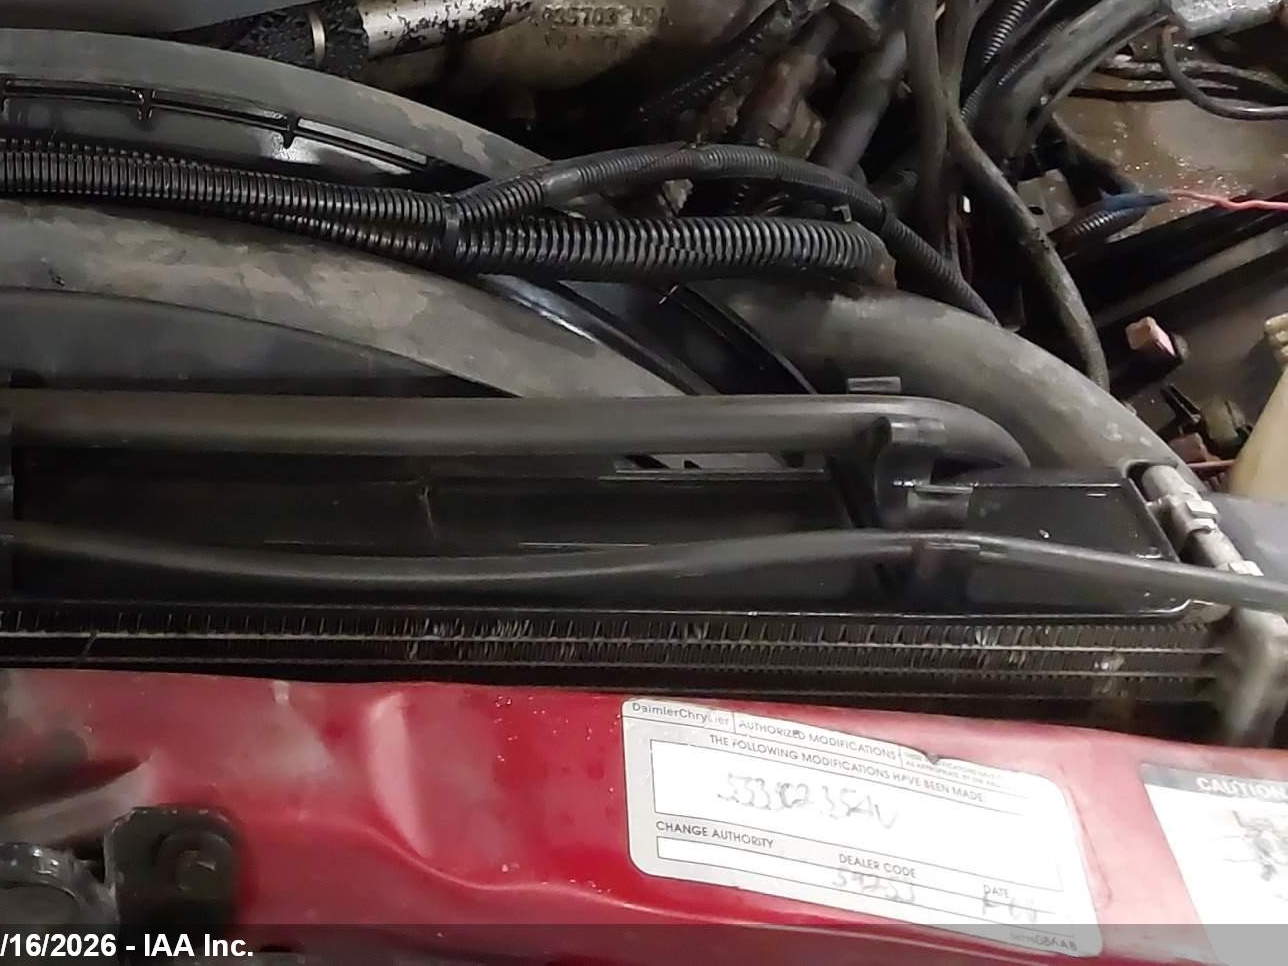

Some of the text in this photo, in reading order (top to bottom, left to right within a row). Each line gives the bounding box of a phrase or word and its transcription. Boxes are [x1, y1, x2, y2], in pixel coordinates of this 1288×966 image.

[739, 720, 806, 741] AUTHORIZED
[809, 733, 897, 761] MODIFICATIONS
[710, 734, 729, 747] THE
[731, 738, 799, 761] FOLLOWING
[802, 752, 890, 780] MODIFICATIONS
[892, 771, 922, 788] HAVE
[922, 777, 951, 795] BEEN
[1196, 777, 1287, 799] CAUTION
[656, 820, 775, 848] CHANGE AUTHORITY
[838, 853, 917, 879] DEALER CODE
[983, 884, 1010, 899] DATE
